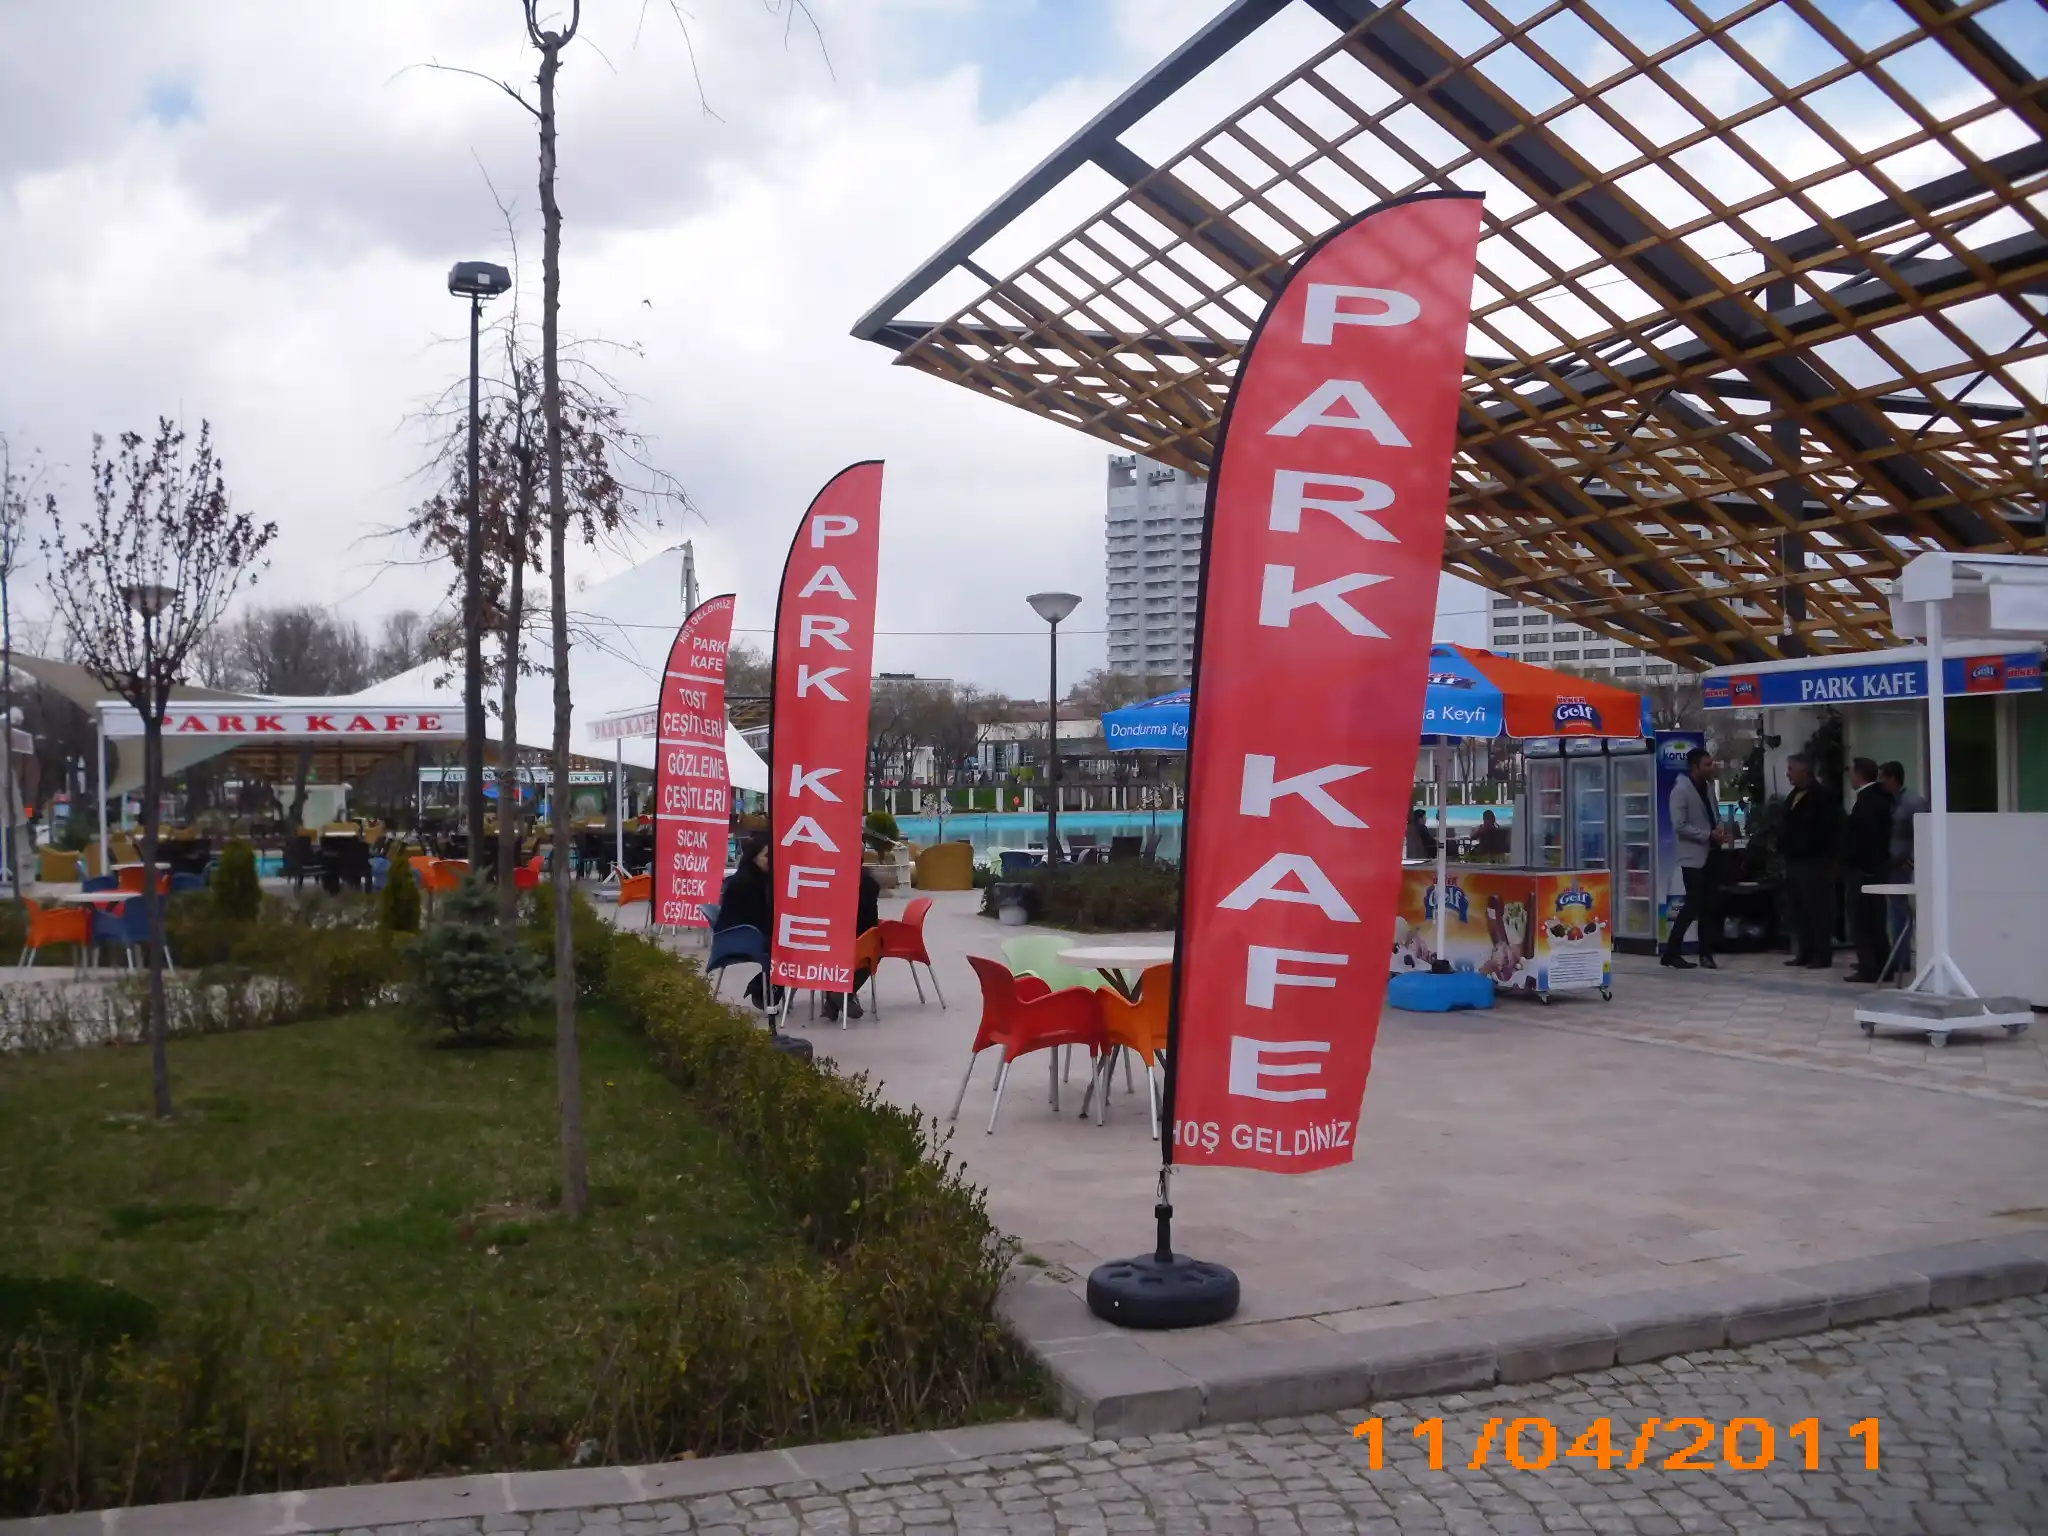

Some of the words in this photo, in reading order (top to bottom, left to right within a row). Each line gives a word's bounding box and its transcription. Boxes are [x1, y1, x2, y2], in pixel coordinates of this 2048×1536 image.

[1258, 283, 1421, 640] PARK
[796, 514, 859, 702] PARK
[692, 636, 728, 653] PARK
[690, 655, 723, 672] KAFE
[1801, 676, 1857, 700] PARK
[1862, 671, 1917, 697] KAFE
[679, 688, 707, 710] TOST
[306, 714, 444, 732] KAFE
[1442, 705, 1486, 724] Keyfi
[1556, 704, 1593, 720] Golf
[663, 711, 723, 739] ÇEŞİTLERİ
[1111, 722, 1167, 737] Dondurma
[1171, 721, 1189, 739] Key
[668, 749, 725, 780] GÖZLEME
[665, 782, 726, 814] ÇEŞİTLERİ
[677, 829, 708, 850] SICAK
[673, 852, 710, 873] SOĞUK
[778, 763, 844, 952] KAFE
[672, 874, 707, 898] İÇECEK
[663, 900, 712, 923] ÇEŞİTLE
[1216, 753, 1374, 1103] KAFE
[779, 962, 850, 983] GELDİNİZ
[1231, 1119, 1351, 1156] GELDİNİZ
